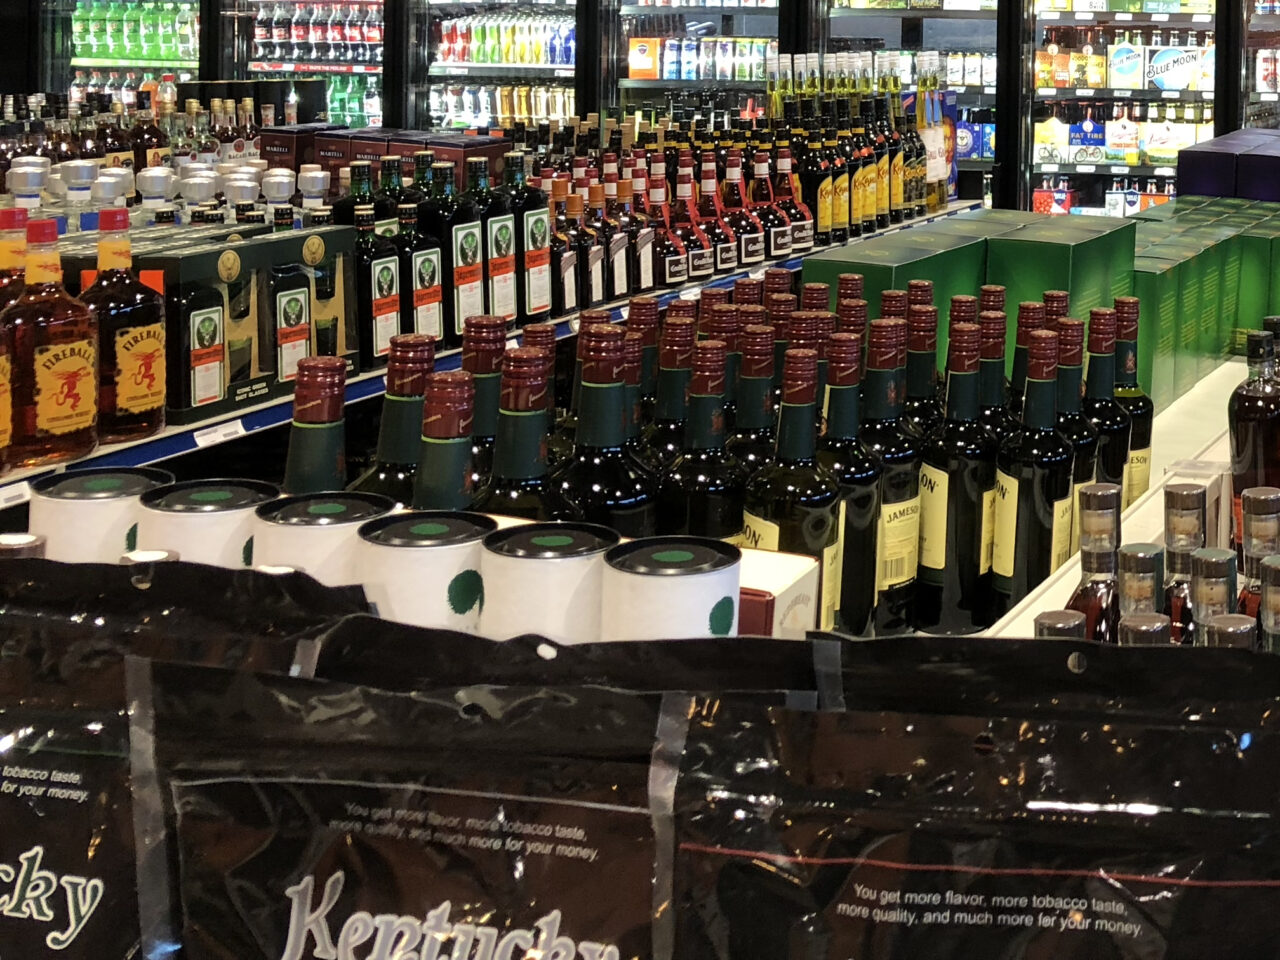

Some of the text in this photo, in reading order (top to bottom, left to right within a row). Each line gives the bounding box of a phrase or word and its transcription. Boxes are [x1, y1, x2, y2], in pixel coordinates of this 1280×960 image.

[1147, 54, 1197, 79] BLUE MOON
[122, 329, 165, 352] FIREBALL
[42, 345, 92, 371] FIREBALL
[886, 505, 920, 525] JAMESO
[3, 765, 82, 784] tobacco taste,
[1, 780, 88, 803] for your money.
[465, 816, 499, 831] more
[502, 820, 552, 837] tobacco
[555, 825, 588, 841] taste,
[469, 835, 500, 850] more
[505, 836, 524, 852] for
[525, 841, 553, 856] your
[556, 843, 600, 863] money.
[854, 882, 1129, 916] You get more flavor, more tobacco taste,
[284, 871, 621, 960] Kentuck
[836, 903, 1144, 939] more quality, and much more for your money.
